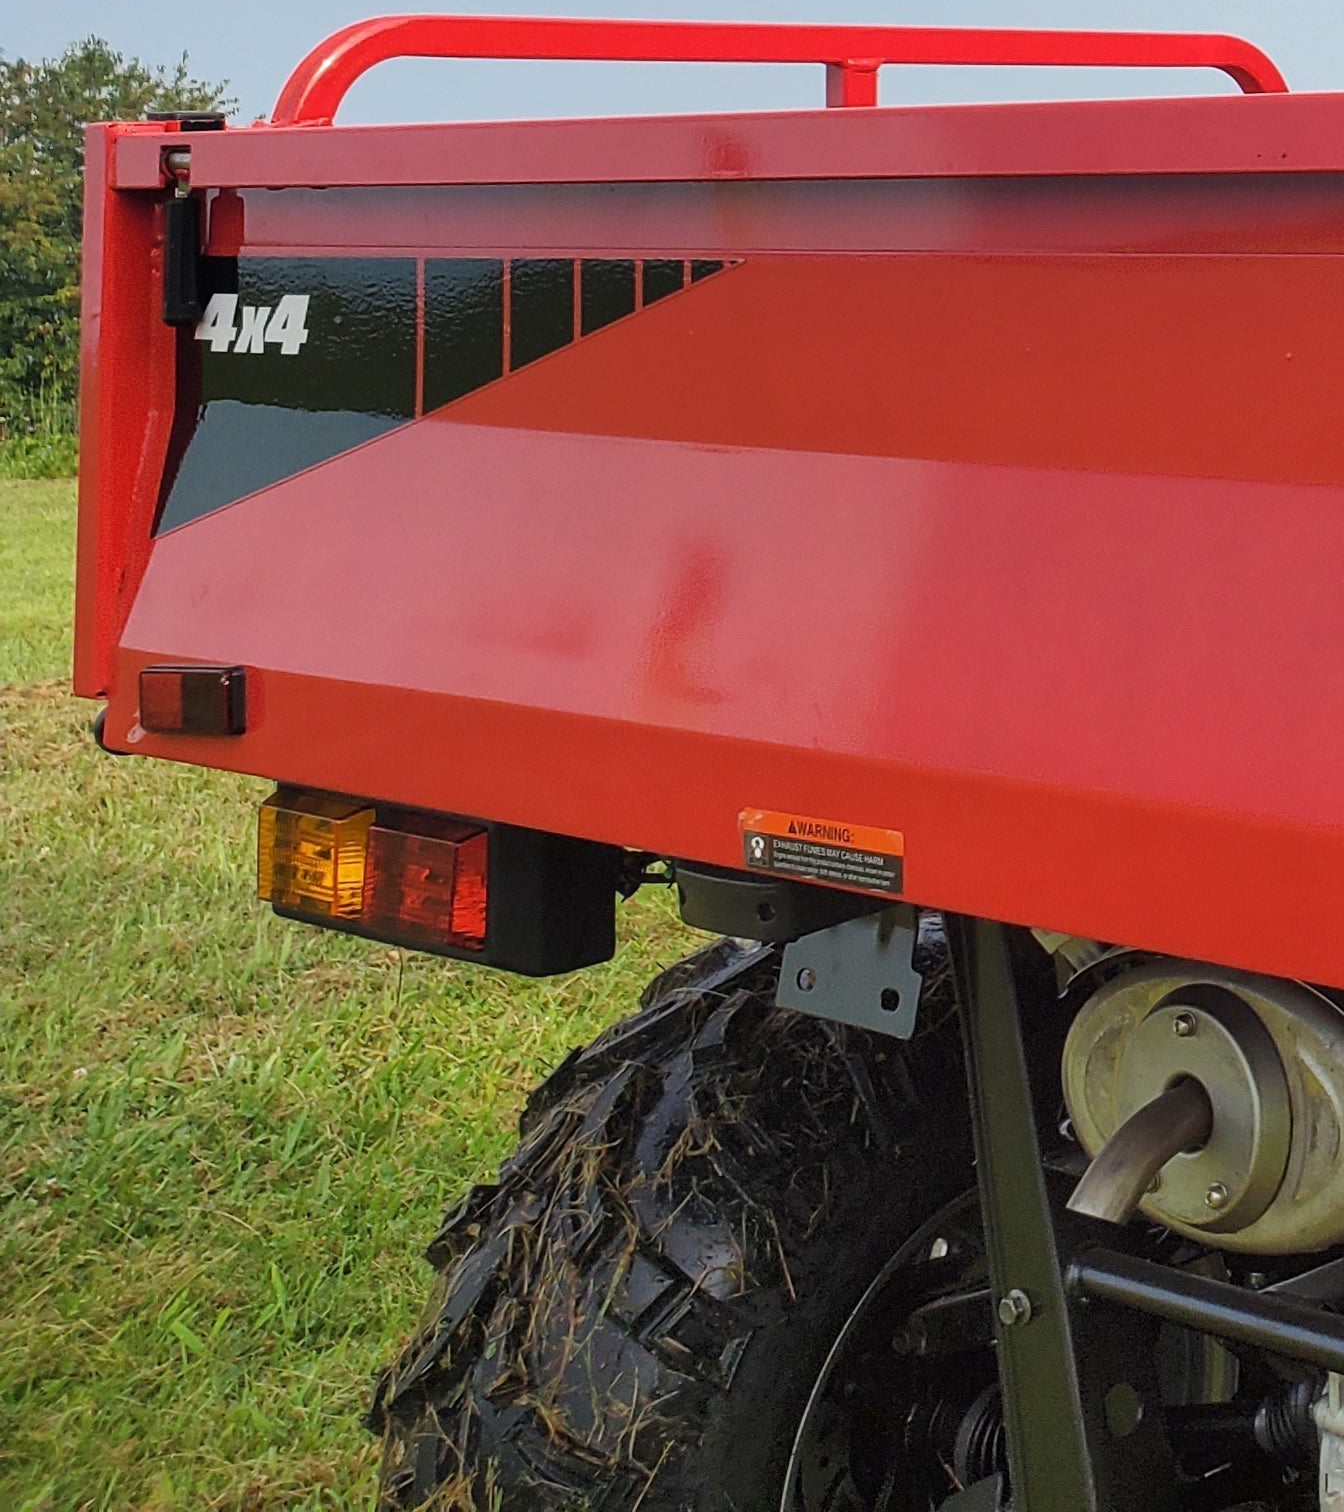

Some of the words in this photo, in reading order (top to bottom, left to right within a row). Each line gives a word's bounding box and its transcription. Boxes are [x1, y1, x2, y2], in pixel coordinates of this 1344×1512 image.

[194, 293, 311, 355] 4x4
[773, 839, 803, 852] EXHAUST
[841, 850, 863, 863] CAUSE
[864, 855, 884, 865] HARM
